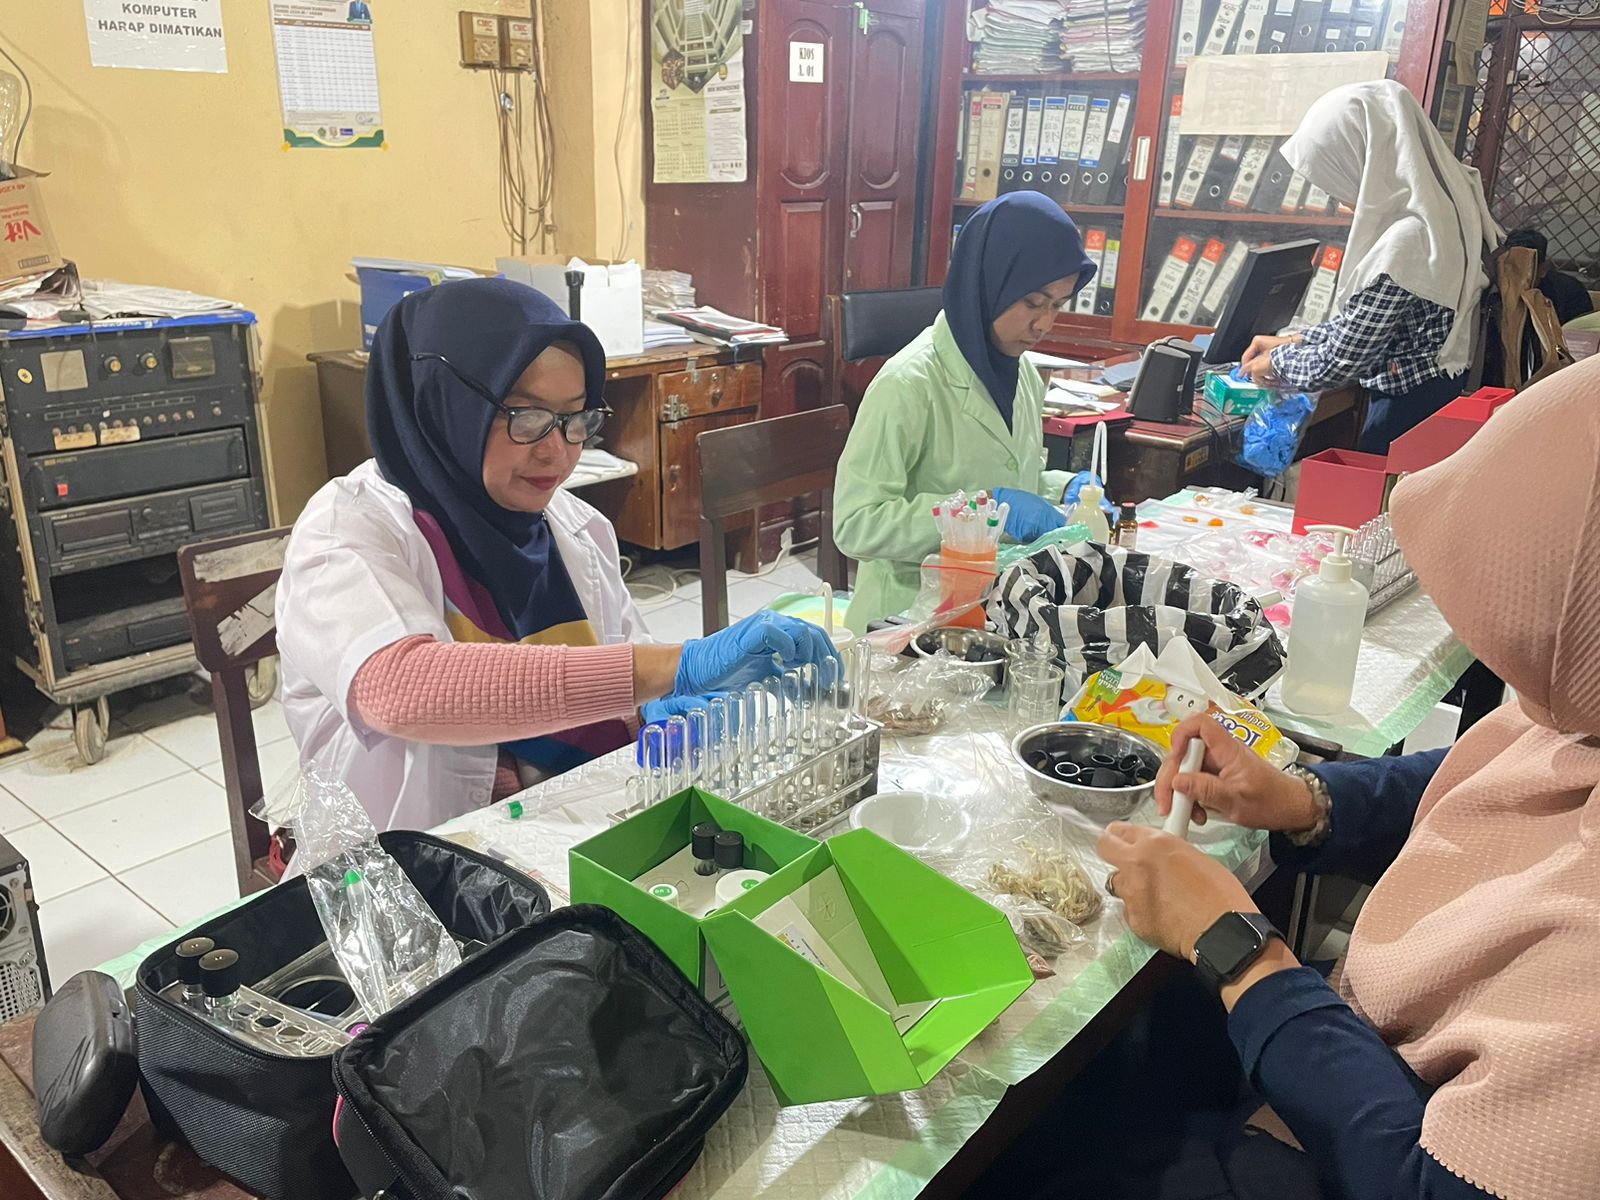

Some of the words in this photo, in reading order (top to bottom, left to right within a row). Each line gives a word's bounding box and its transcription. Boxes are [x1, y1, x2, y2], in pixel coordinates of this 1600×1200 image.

[122, 3, 197, 19] KOMPUTER
[98, 20, 145, 33] HARAP
[149, 23, 222, 38] DIMATIKAN
[4, 219, 42, 243] Vit
[1239, 711, 1271, 732] Facial
